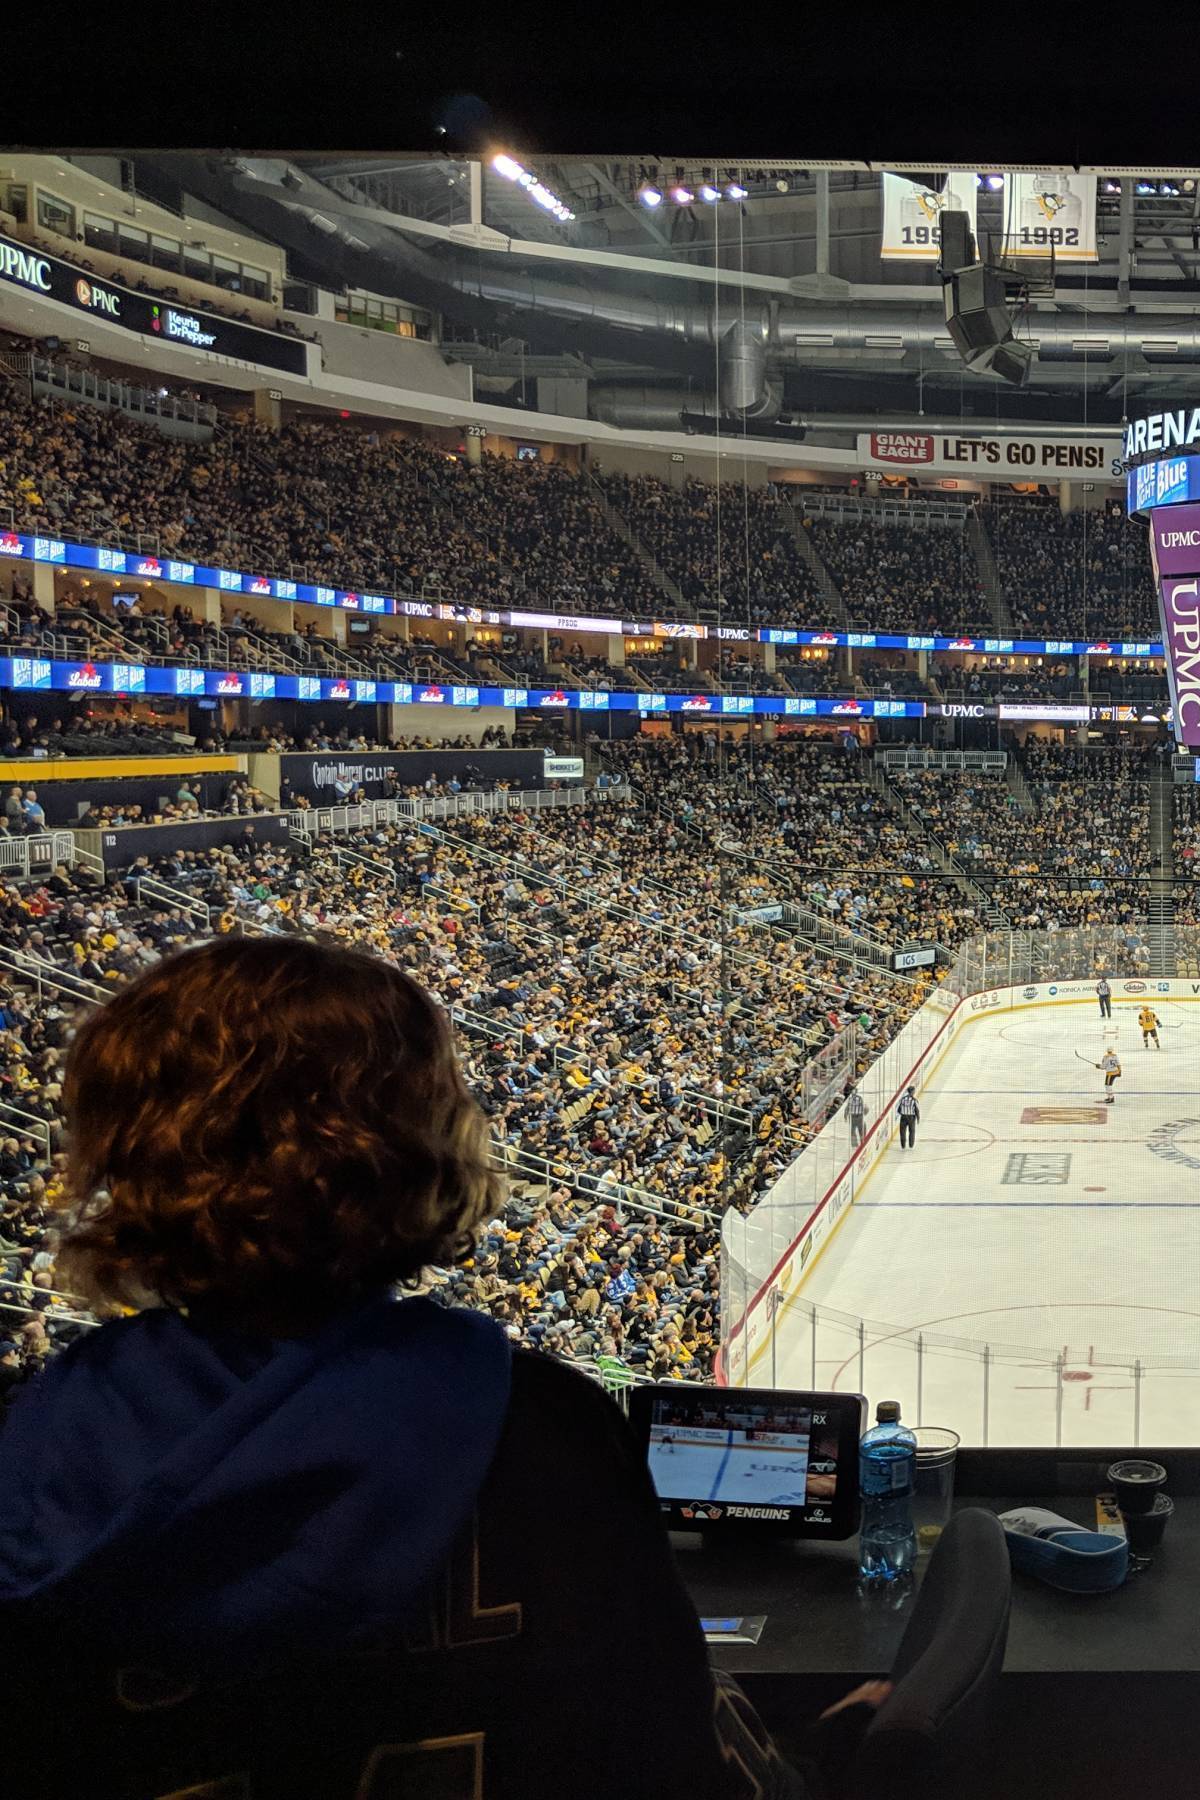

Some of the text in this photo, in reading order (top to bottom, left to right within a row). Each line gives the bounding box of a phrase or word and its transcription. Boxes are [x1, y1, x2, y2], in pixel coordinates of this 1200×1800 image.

[1020, 226, 1079, 246] 1992
[92, 287, 120, 315] PNC
[169, 311, 200, 332] Keurig
[467, 425, 487, 437] 224
[876, 434, 928, 448] GIANT
[877, 446, 927, 459] EAGLE
[943, 439, 1000, 463] LET'S
[1006, 442, 1038, 465] GO
[1042, 445, 1103, 468] PENS!
[865, 472, 882, 481] 226
[1157, 461, 1187, 502] Blue
[1161, 531, 1200, 547] UPMC
[405, 602, 432, 616] UPMC
[717, 628, 749, 641] UPMC
[69, 671, 102, 687] Labatt
[763, 712, 780, 721] 116
[941, 705, 984, 718] UPMC
[312, 761, 336, 789] Captain
[365, 766, 394, 782] CLU
[509, 796, 520, 807] 115
[320, 818, 331, 828] 113
[106, 835, 116, 846] 112
[35, 844, 50, 860] 111
[902, 956, 915, 966] IGS
[812, 1414, 826, 1425] RX
[726, 1506, 791, 1520] PENGUINS
